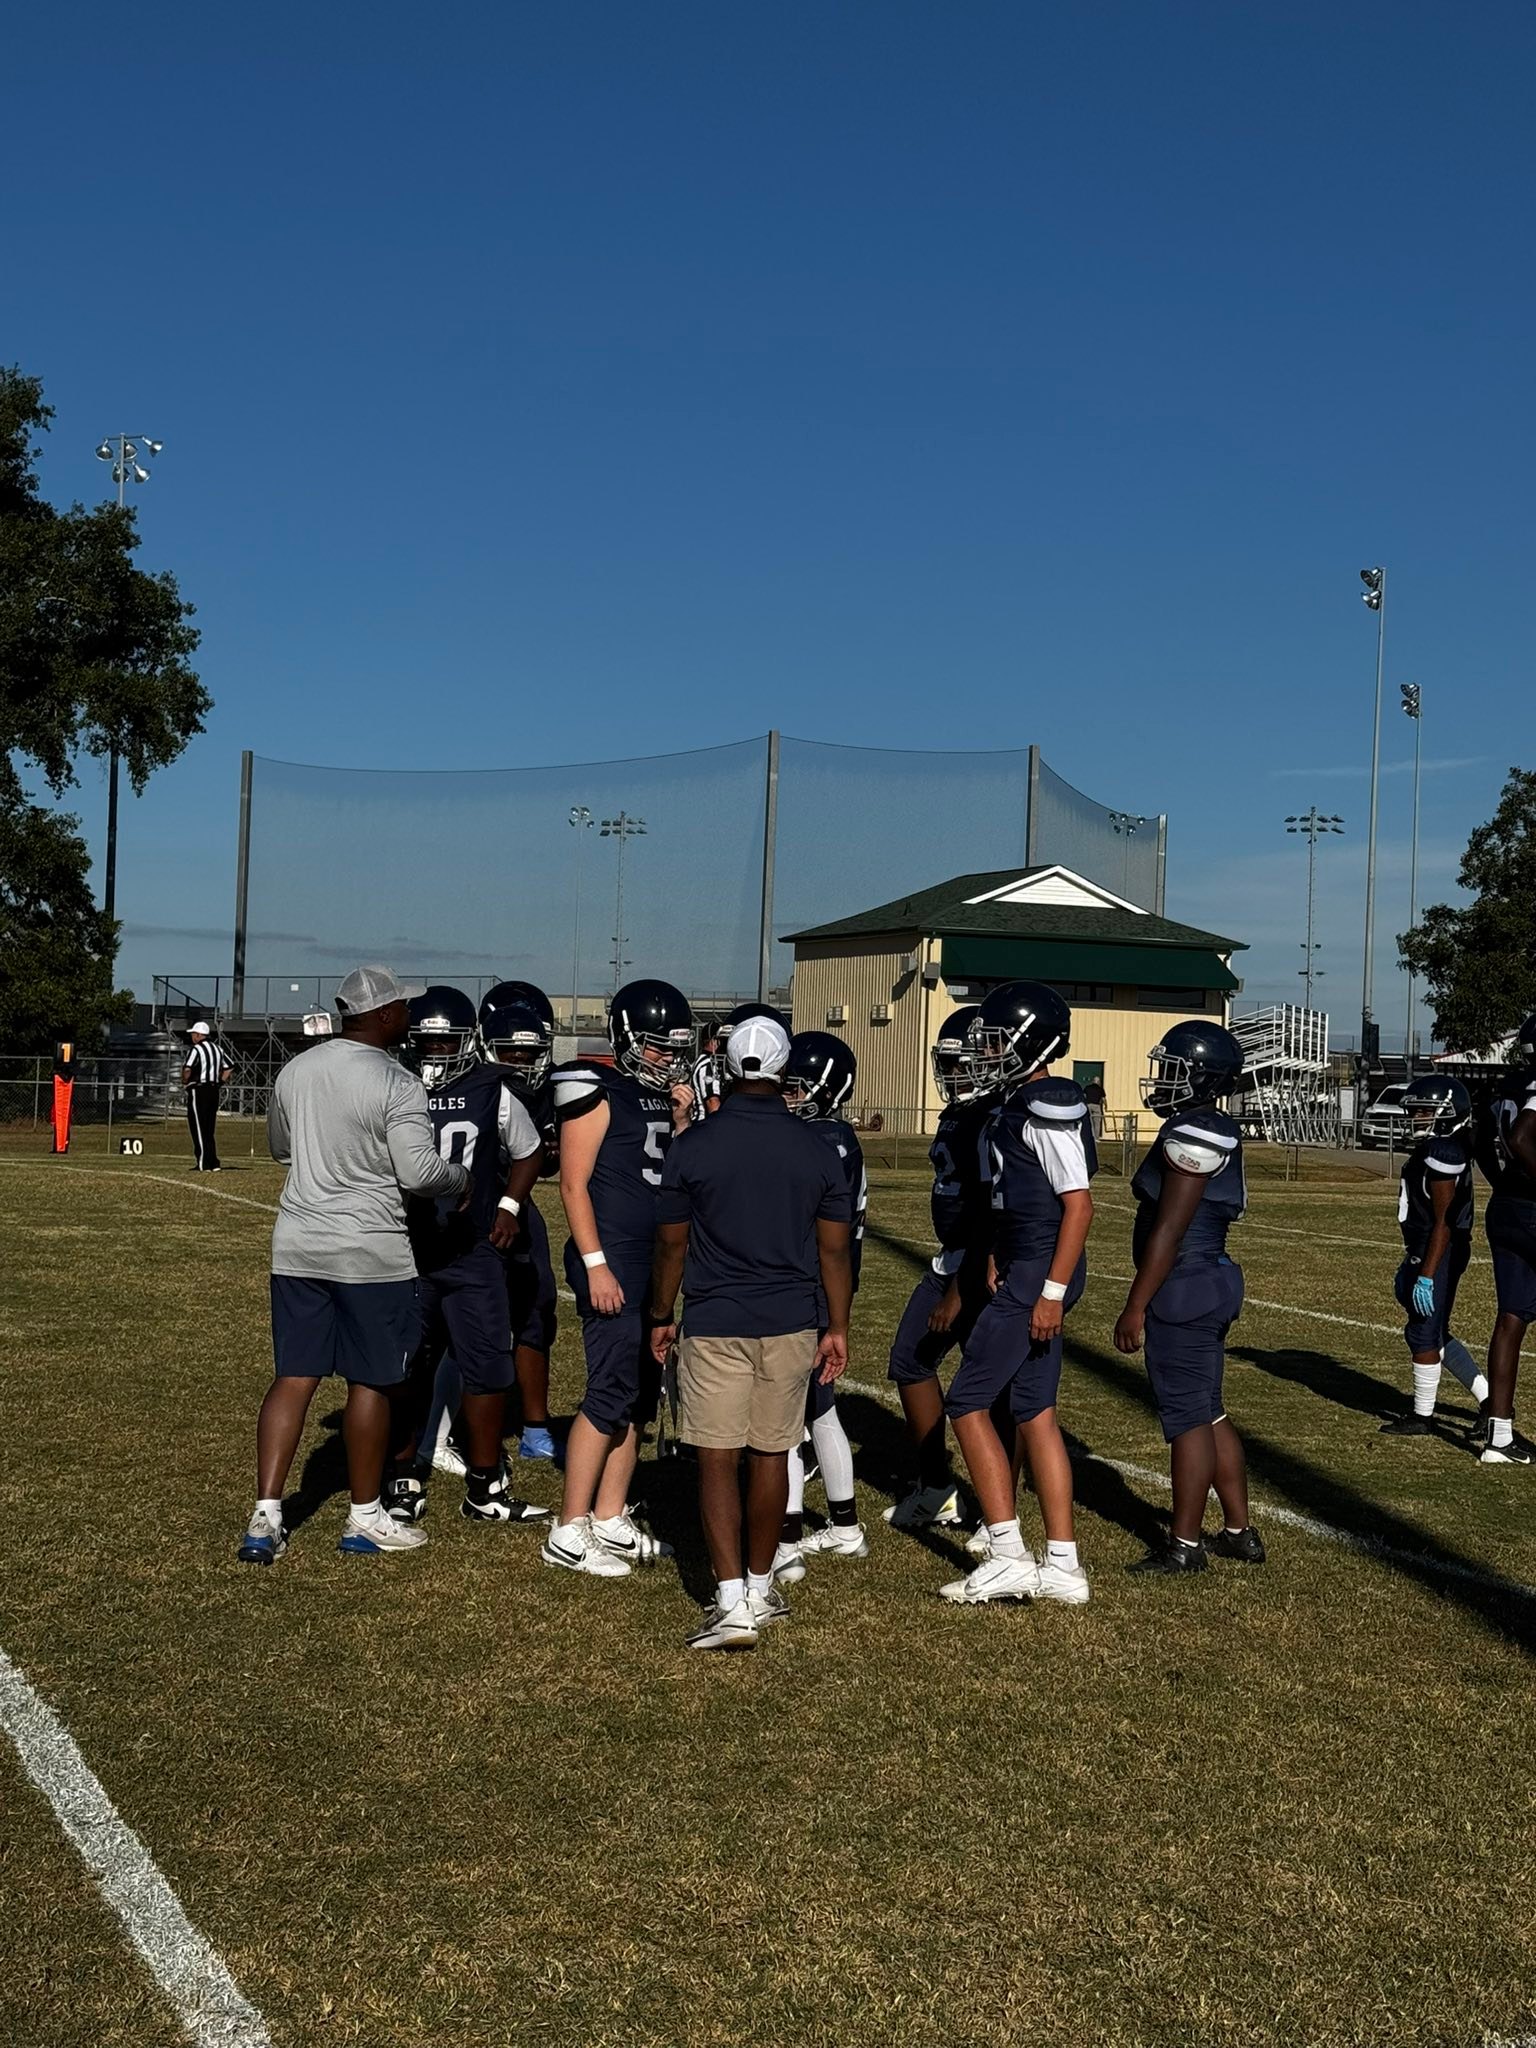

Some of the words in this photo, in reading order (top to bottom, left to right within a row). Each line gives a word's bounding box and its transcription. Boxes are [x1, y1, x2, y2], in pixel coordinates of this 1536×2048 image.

[61, 1043, 71, 1063] 1
[429, 1097, 466, 1111] GLES
[123, 1140, 143, 1155] 10
